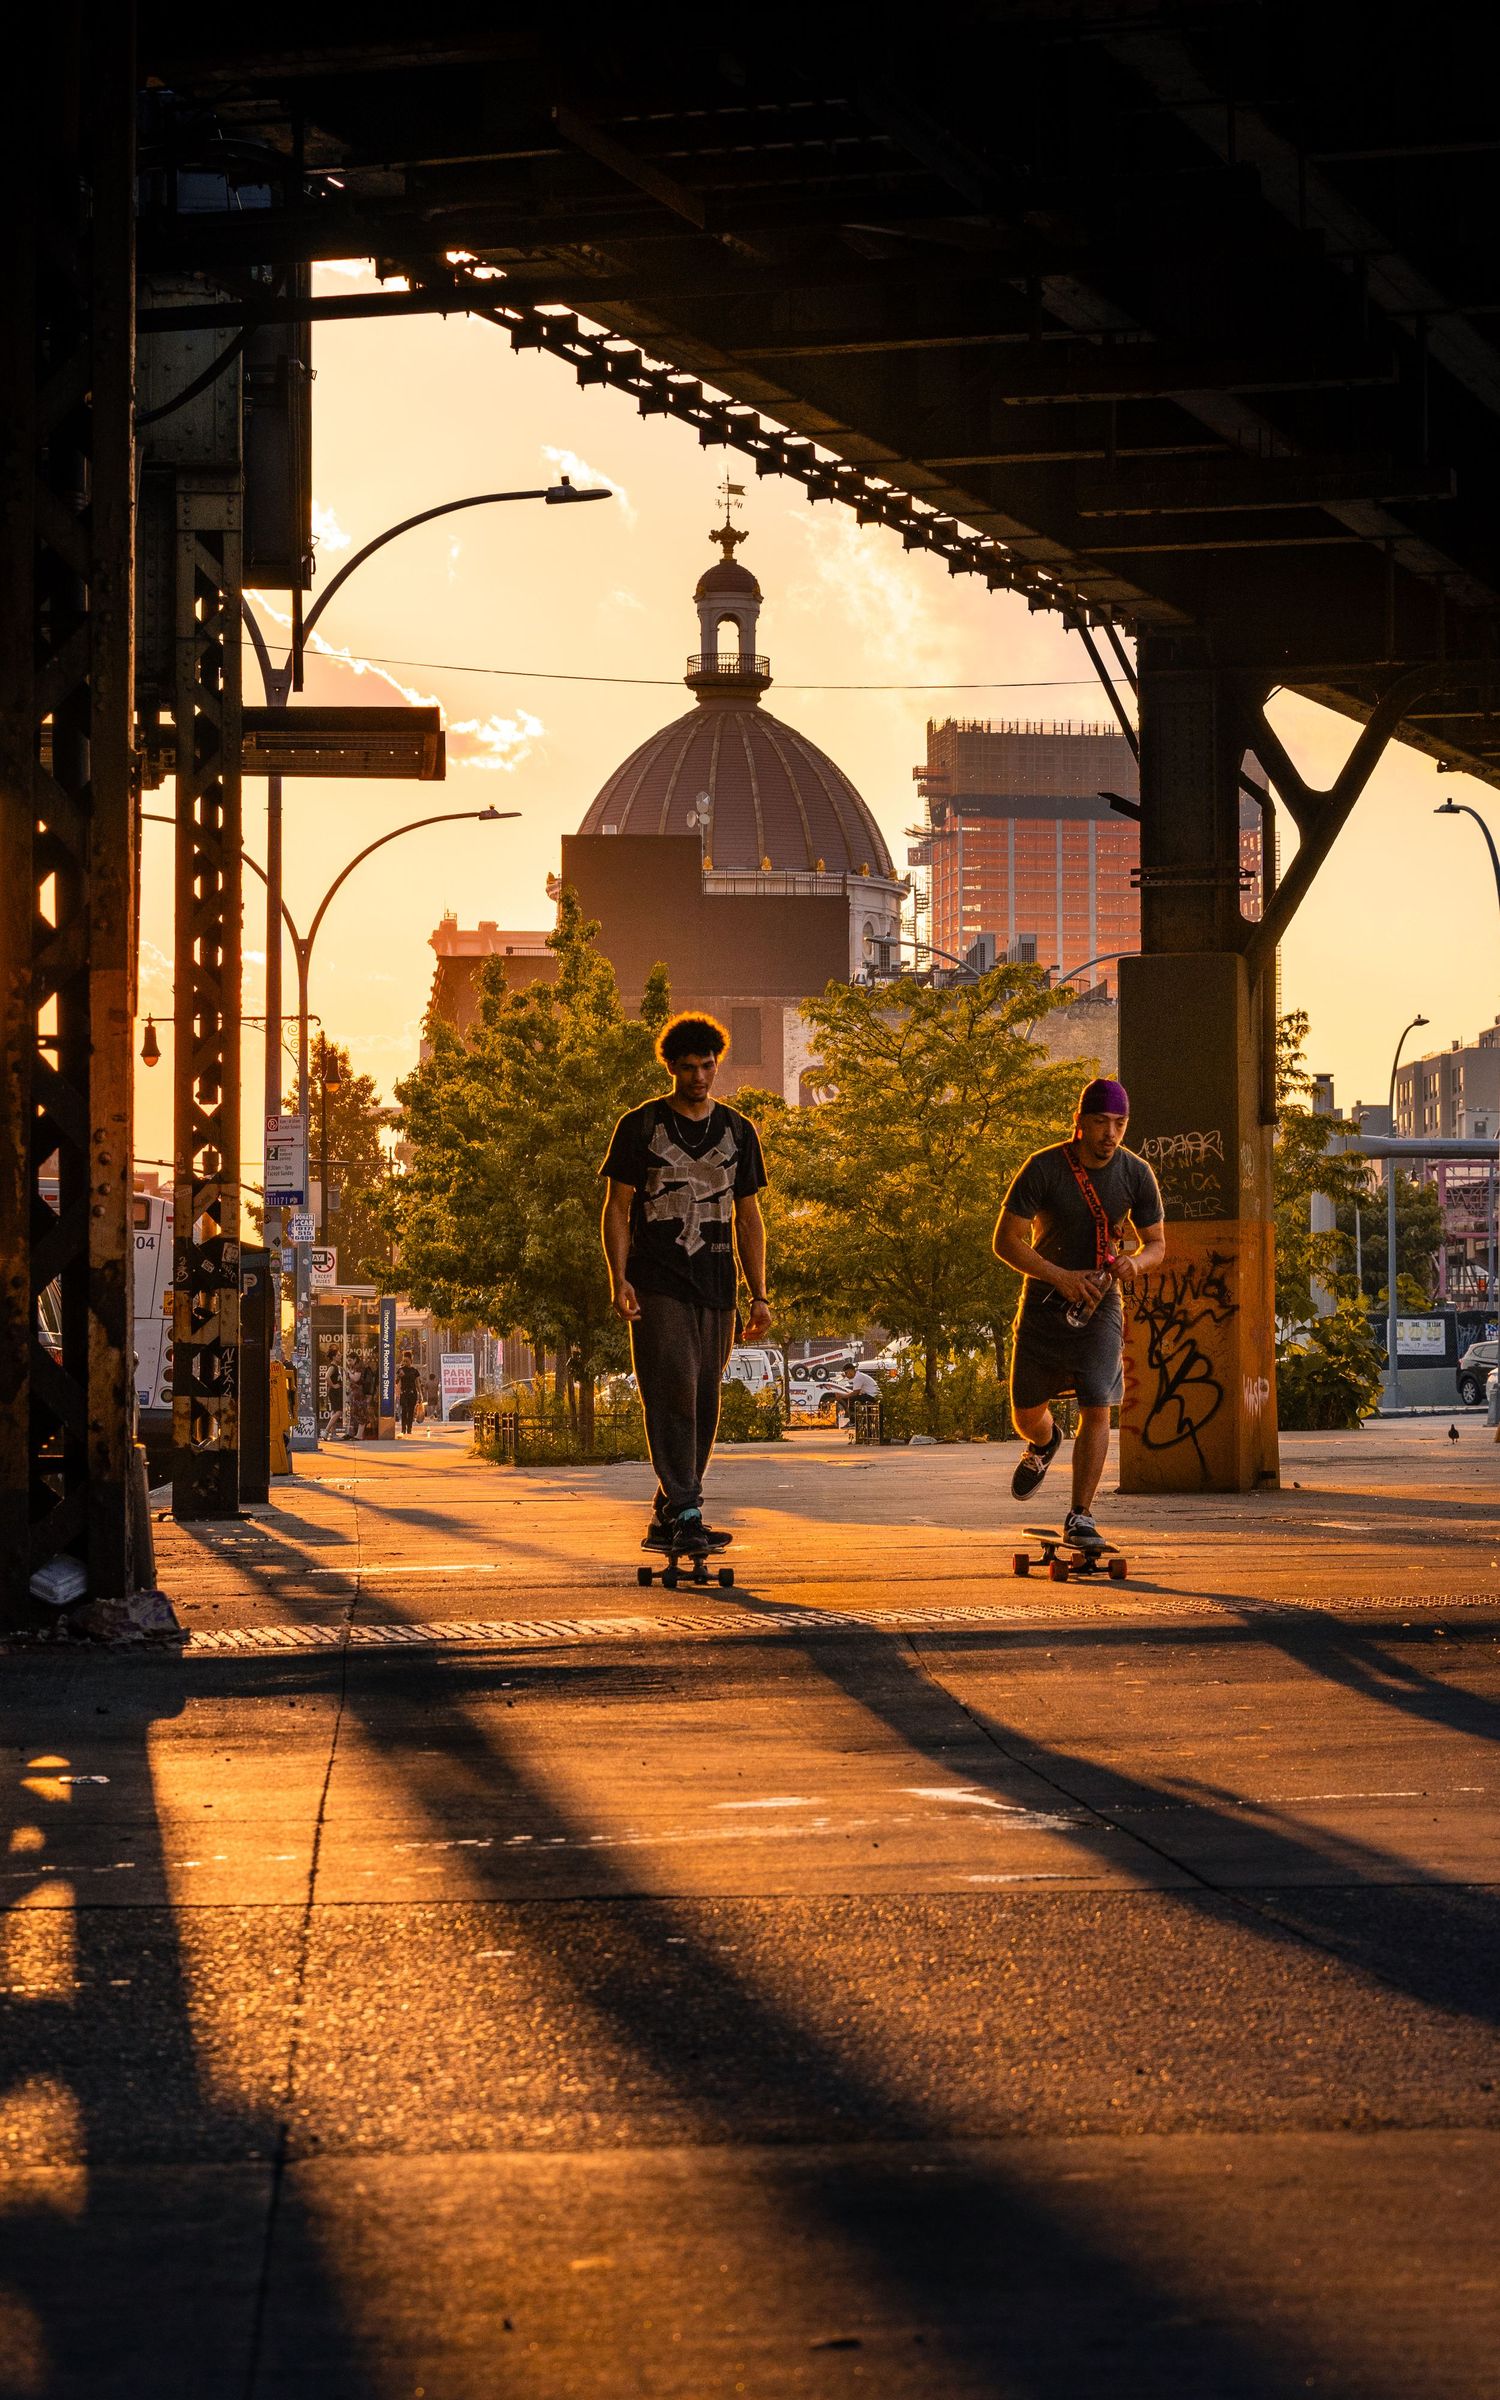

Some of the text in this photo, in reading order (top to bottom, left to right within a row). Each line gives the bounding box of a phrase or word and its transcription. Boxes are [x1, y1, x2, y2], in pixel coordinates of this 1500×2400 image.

[269, 1147, 276, 1160] 2
[301, 1219, 315, 1227] CAR
[383, 1309, 391, 1343] Broadway
[319, 1333, 333, 1344] NO
[382, 1349, 391, 1379] Roebling
[443, 1369, 473, 1377] PARK
[319, 1365, 328, 1398] BETTER
[443, 1377, 473, 1386] HERE
